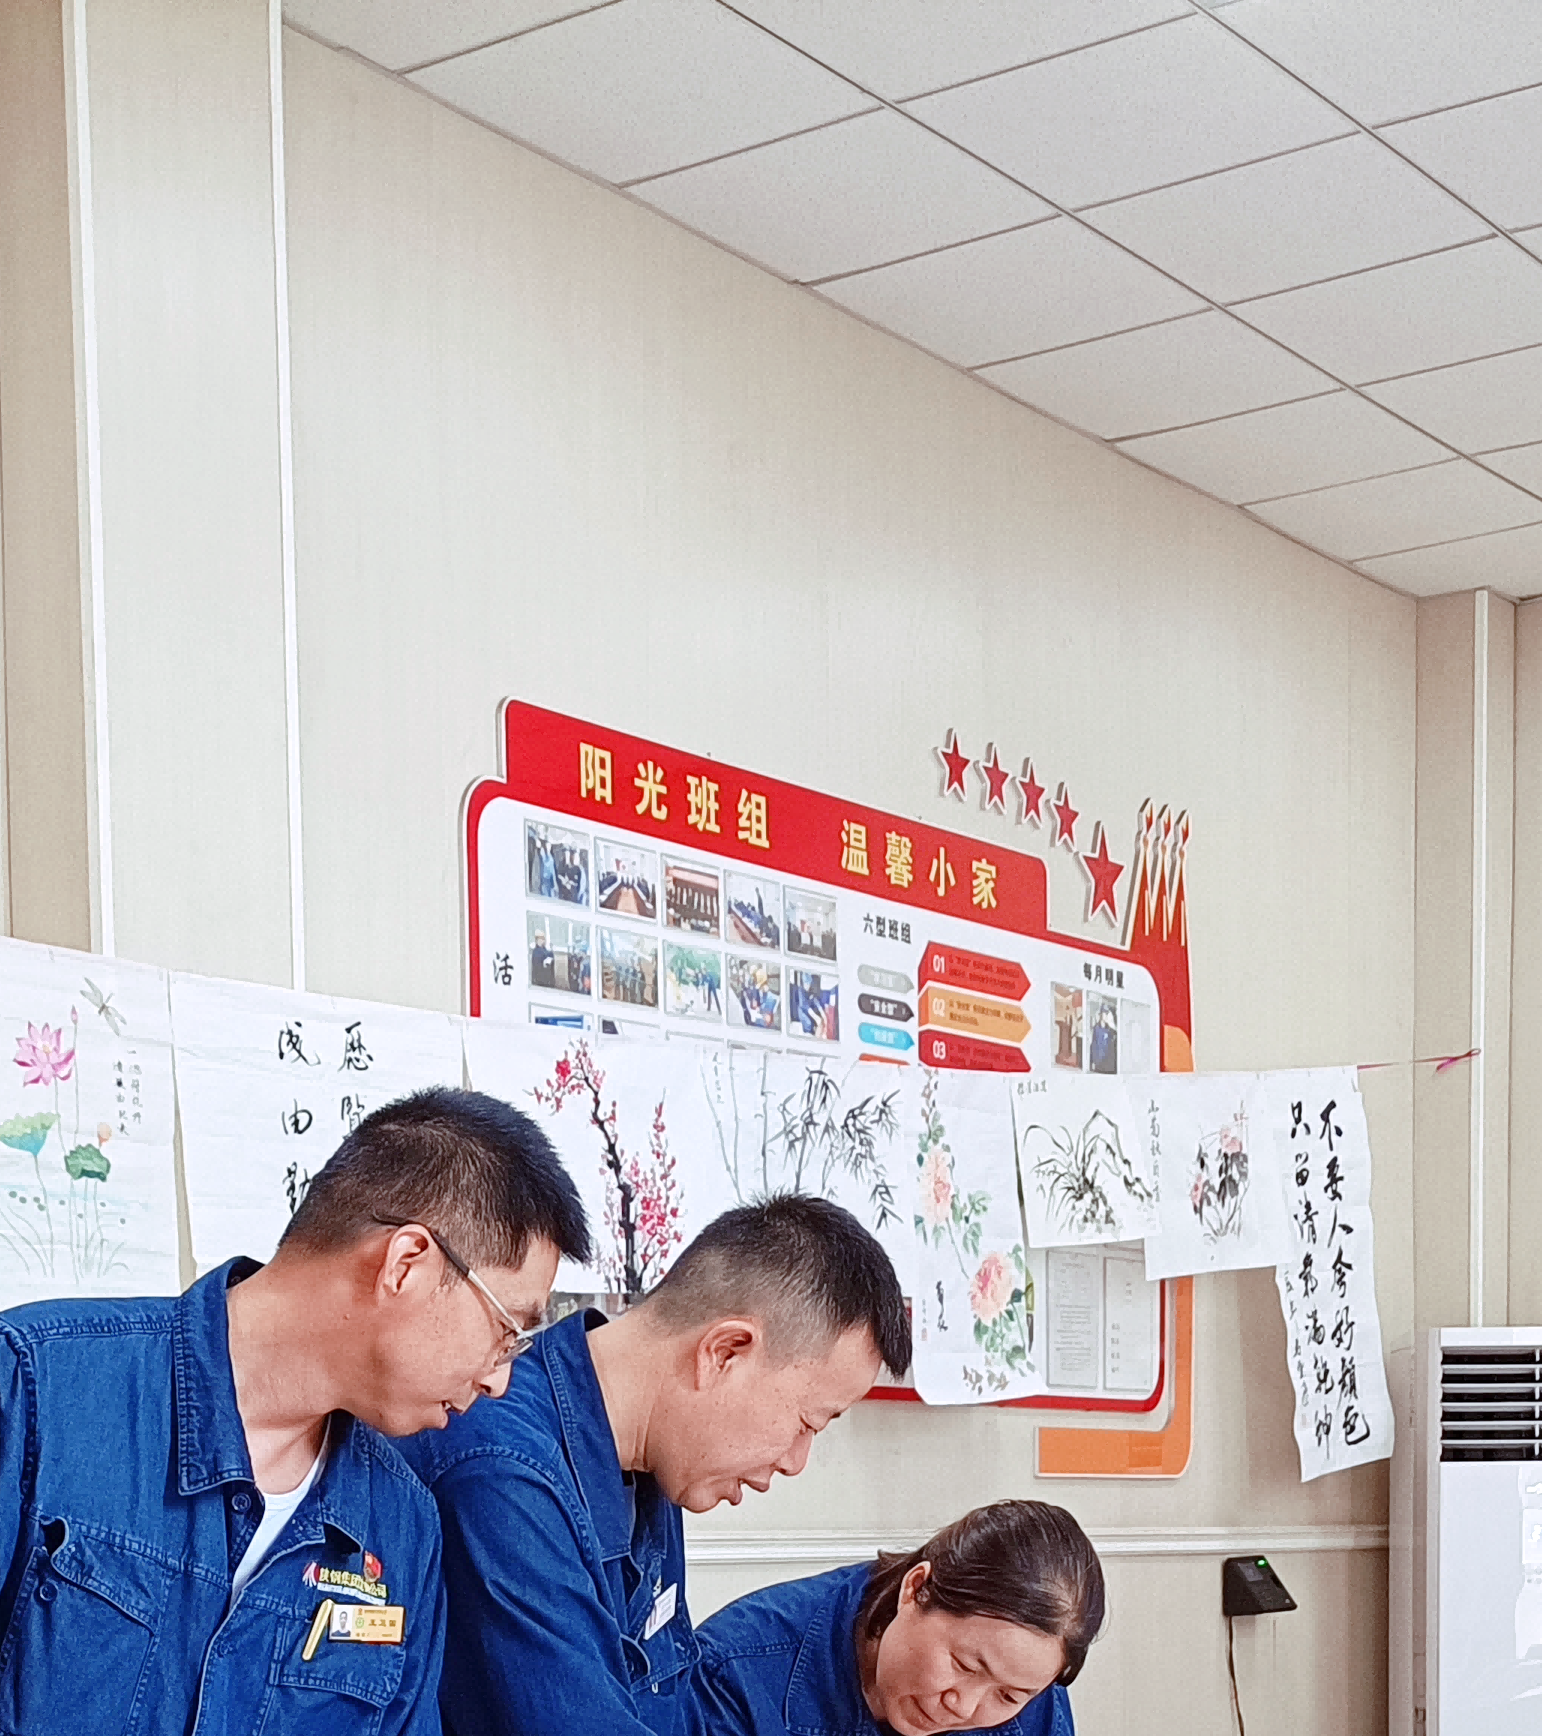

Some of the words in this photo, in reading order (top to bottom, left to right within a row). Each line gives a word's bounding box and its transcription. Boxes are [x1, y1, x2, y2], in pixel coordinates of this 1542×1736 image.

[579, 741, 770, 849] 阳光班组
[840, 819, 998, 910] 温馨小家
[861, 913, 912, 944] 六型班组
[491, 951, 515, 986] 活
[933, 954, 946, 974] 01
[1083, 962, 1125, 989] 每月明星
[933, 997, 946, 1017] 02
[933, 1040, 947, 1060] 03
